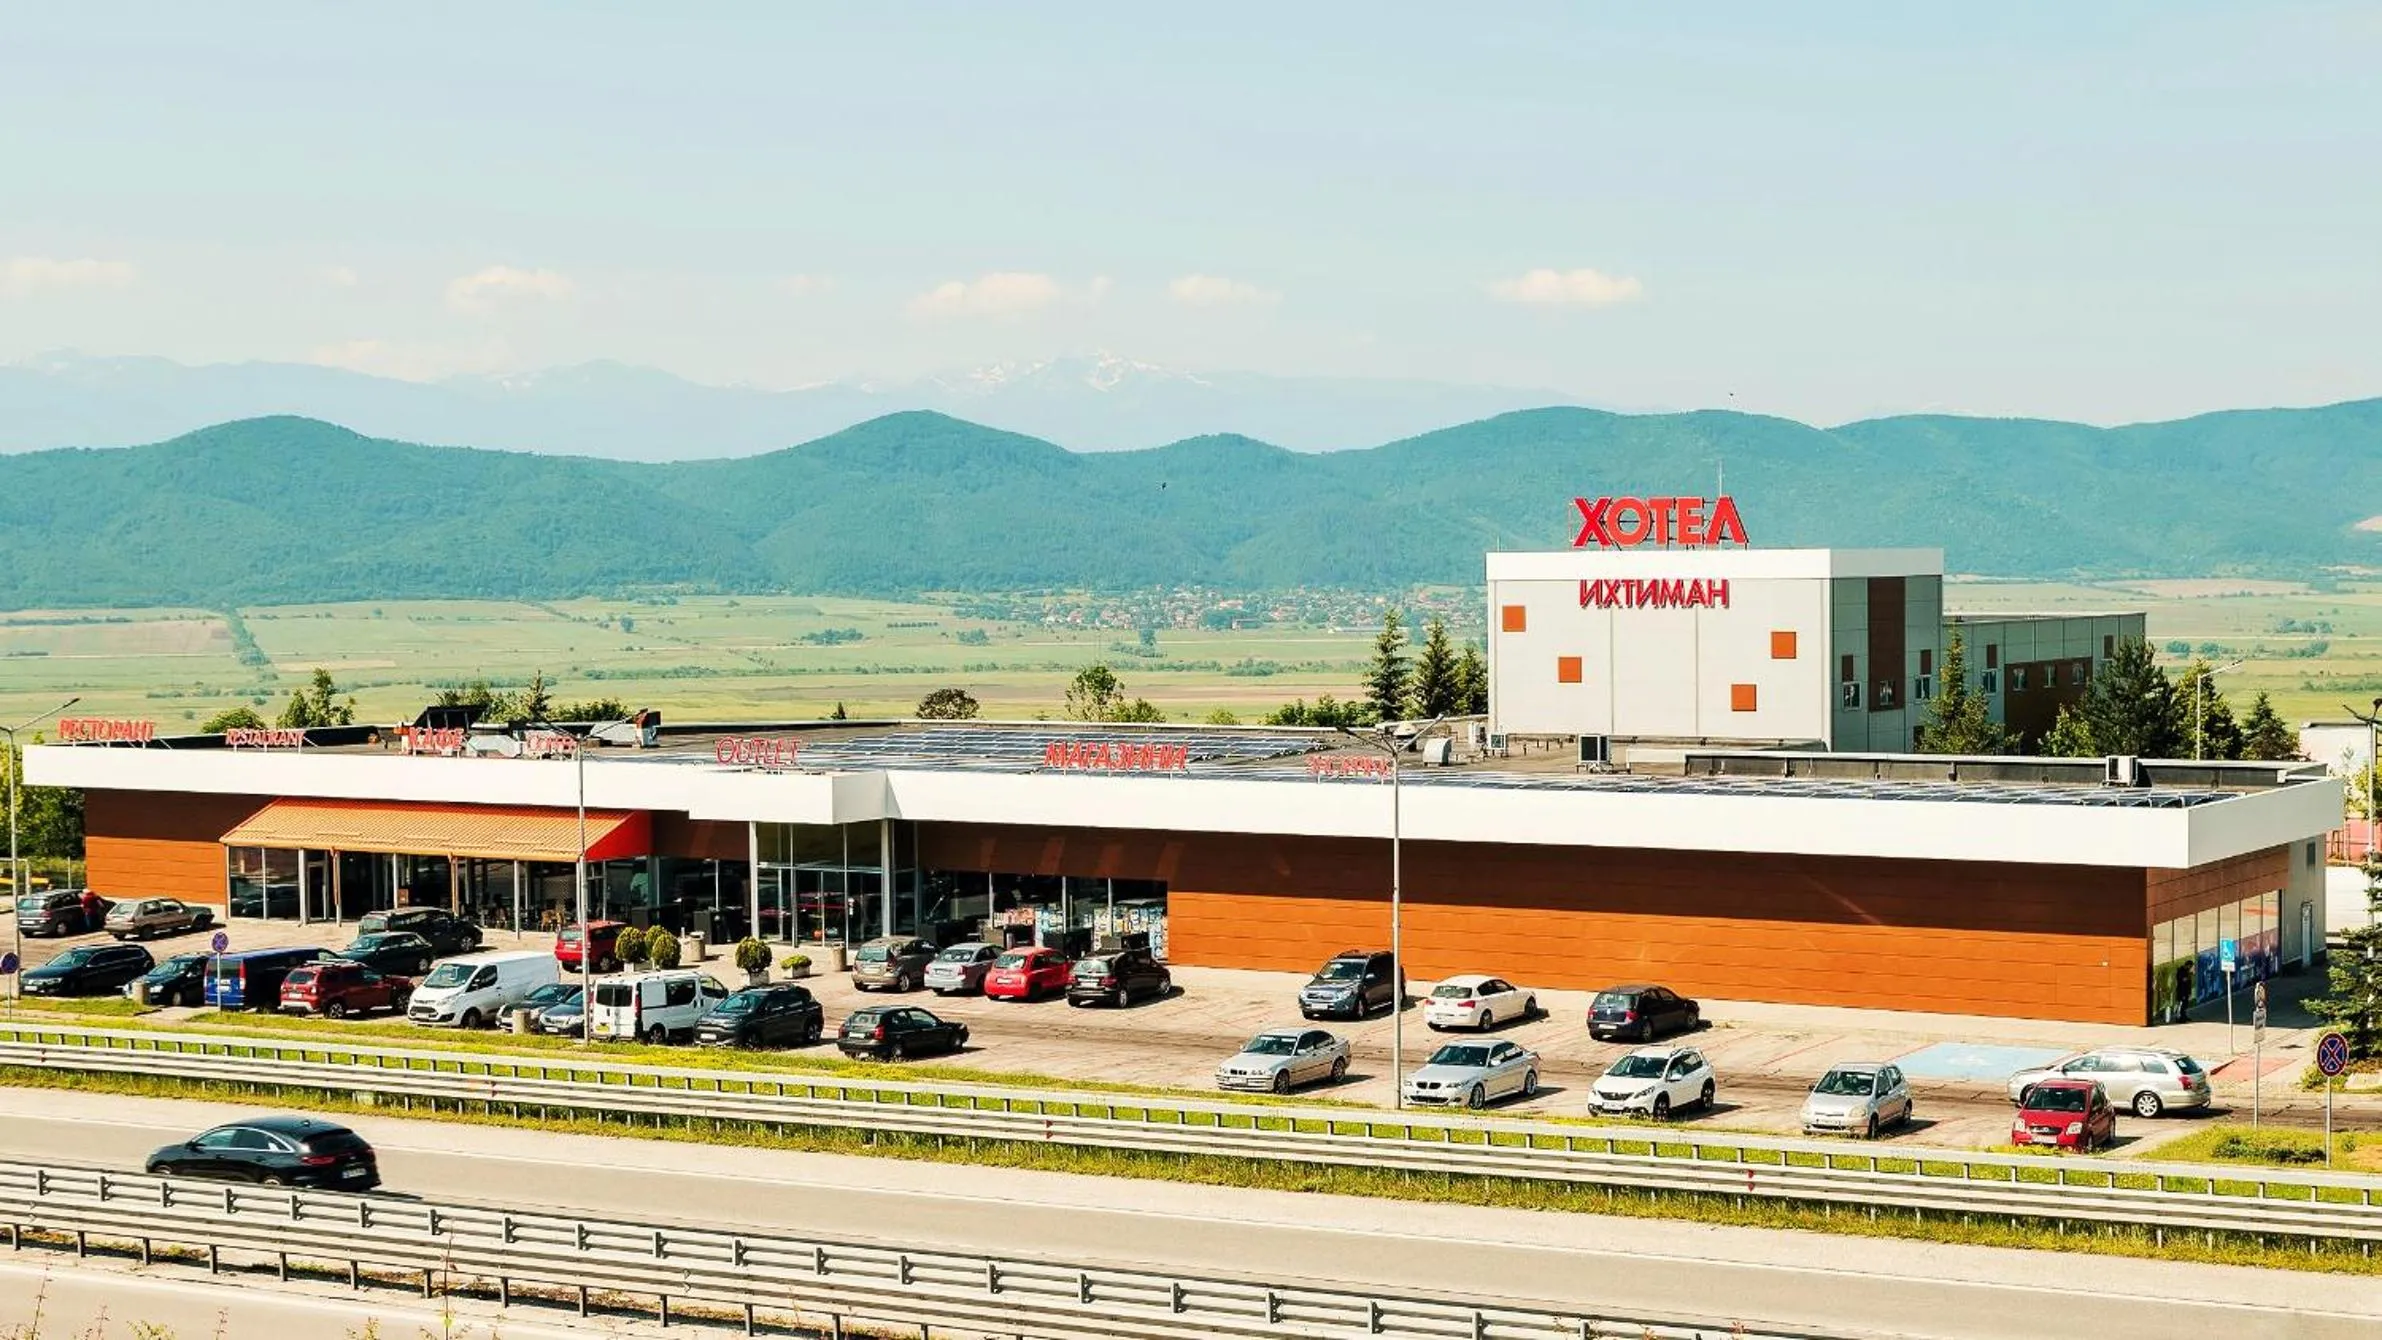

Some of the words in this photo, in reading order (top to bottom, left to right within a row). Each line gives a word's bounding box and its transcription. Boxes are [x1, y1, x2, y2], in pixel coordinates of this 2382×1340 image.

[1573, 496, 1749, 548] ХОТЕЛ
[1579, 578, 1730, 608] ИХТИМАН
[59, 717, 155, 742] РЕСТОРАНТ
[226, 729, 306, 746] RESTAURANT
[716, 736, 804, 766] OUTLET
[1044, 741, 1189, 770] МАГАЗИНИ
